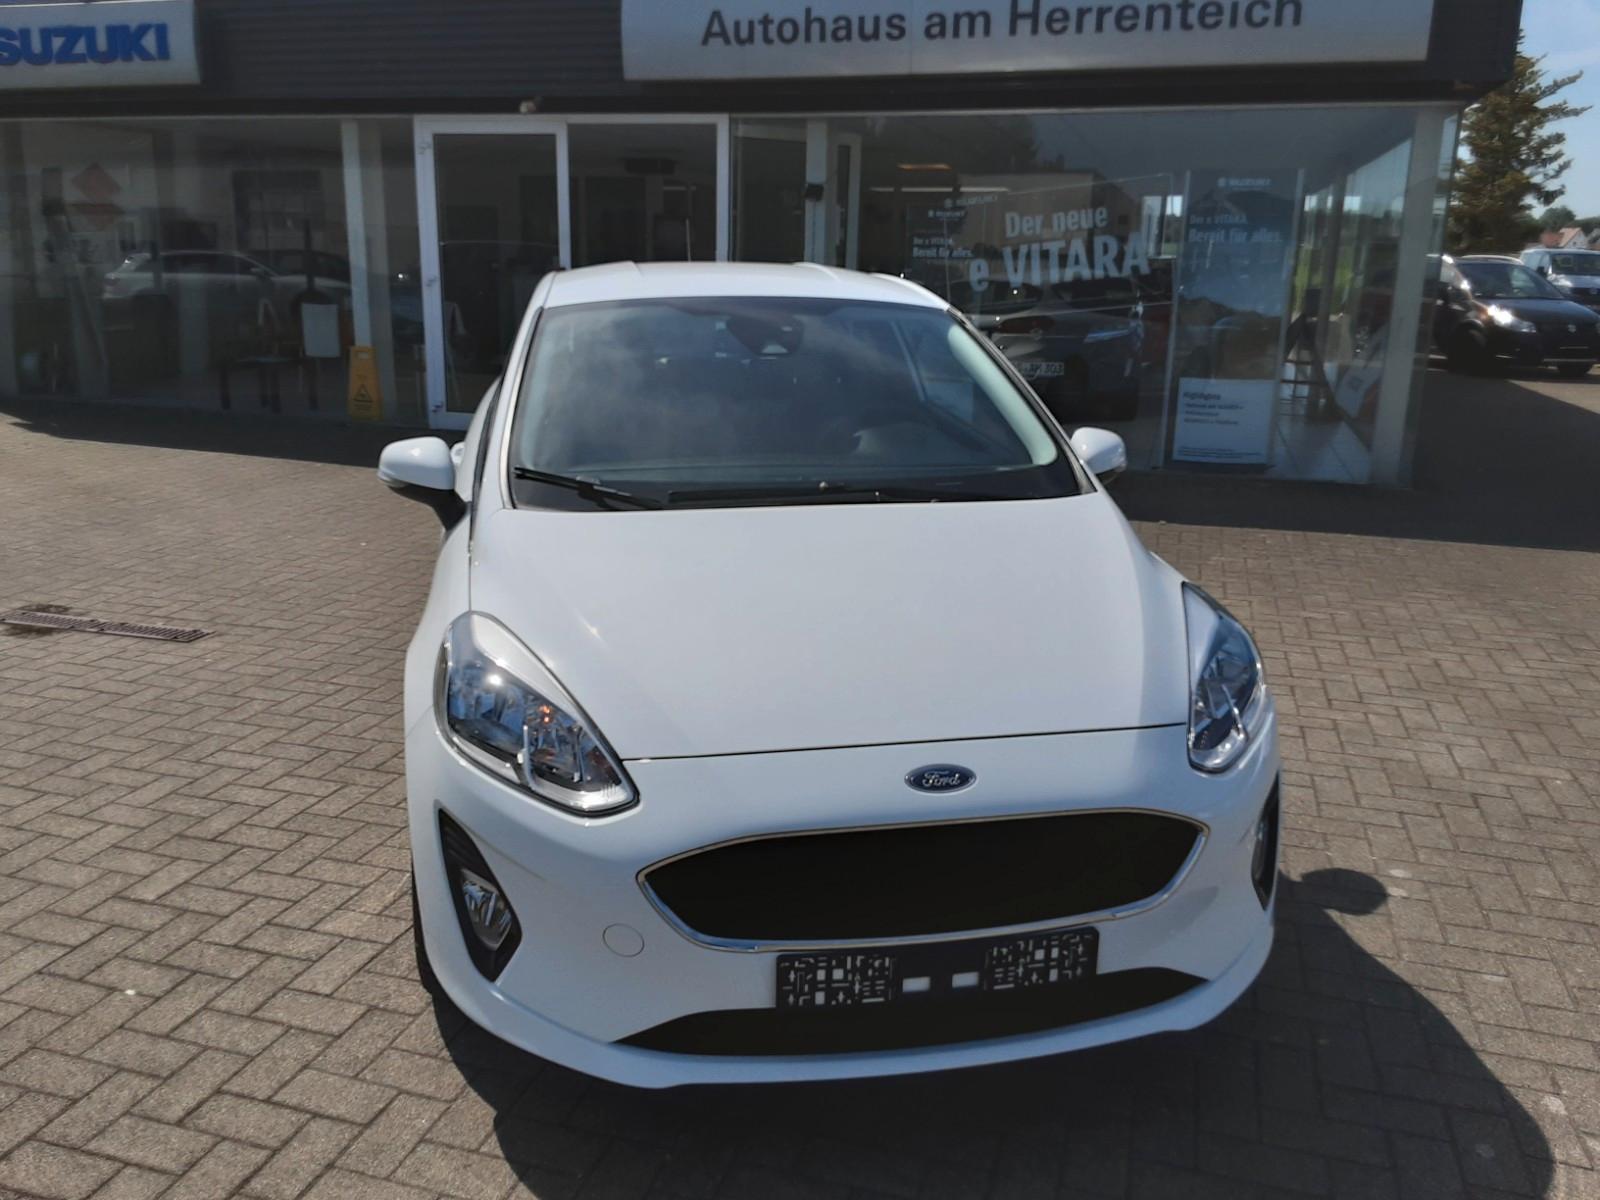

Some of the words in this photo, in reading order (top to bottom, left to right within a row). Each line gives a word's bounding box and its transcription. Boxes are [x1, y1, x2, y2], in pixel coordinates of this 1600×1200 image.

[0, 23, 170, 65] SUZUKI
[701, 7, 906, 46] Autohaus
[924, 9, 991, 40] am
[1008, 0, 1302, 36] Herrenteich
[1005, 211, 1043, 239] Der
[1052, 206, 1109, 233] neue
[969, 258, 989, 292] e
[1002, 232, 1152, 288] VITARA
[922, 771, 960, 787] Ford
